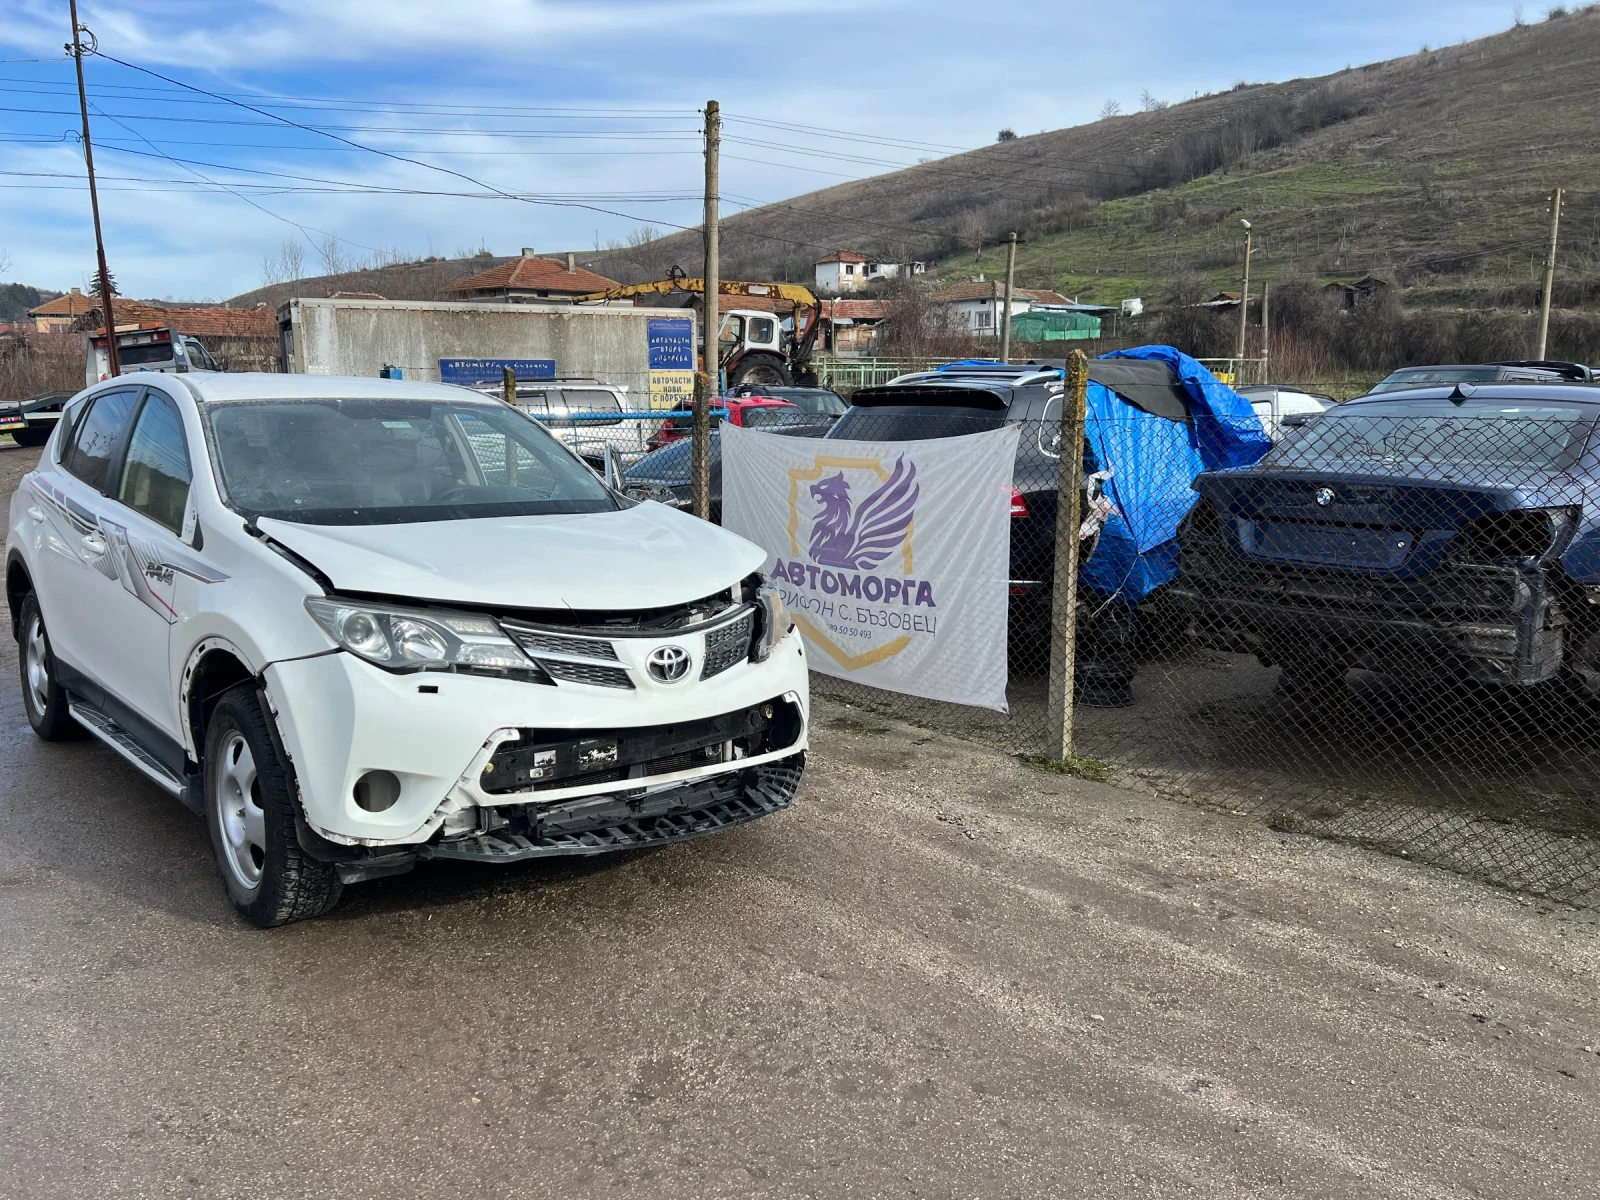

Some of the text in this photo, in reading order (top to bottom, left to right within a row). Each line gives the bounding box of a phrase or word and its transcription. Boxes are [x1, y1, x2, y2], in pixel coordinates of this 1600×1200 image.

[652, 376, 691, 384] АВТОЧАСТИ
[663, 385, 682, 393] НОВИ
[653, 394, 658, 402] С
[770, 557, 936, 607] АВТОМОРГА
[779, 589, 937, 636] РИФОН С. БЪЗОВЕЦ
[827, 623, 872, 639] 89 50 50 493
